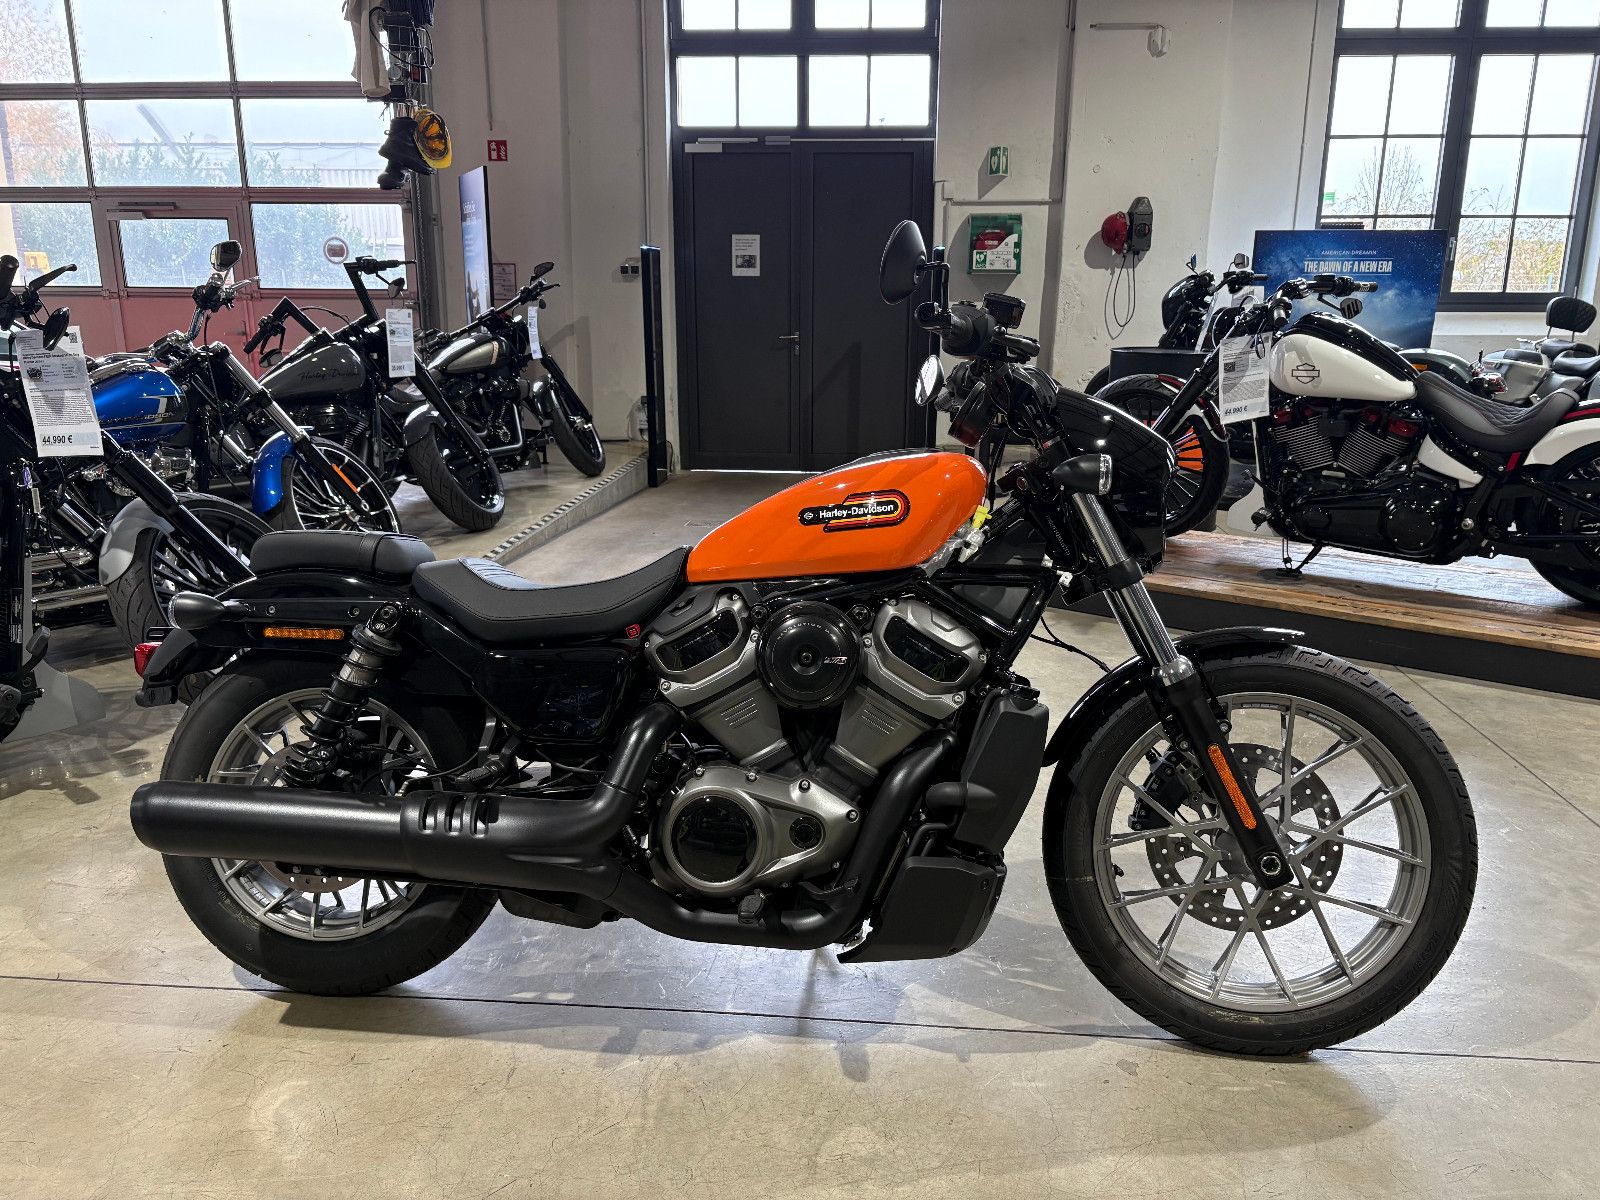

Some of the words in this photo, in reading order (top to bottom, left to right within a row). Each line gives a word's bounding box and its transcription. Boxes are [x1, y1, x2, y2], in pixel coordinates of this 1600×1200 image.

[1304, 261, 1319, 273] THE
[1319, 261, 1342, 273] DAWN
[1343, 261, 1353, 273] OF
[1353, 261, 1359, 273] A
[1359, 261, 1378, 273] NEW
[1377, 260, 1393, 273] ERA
[42, 436, 66, 445] 44.990
[67, 435, 73, 444] €
[819, 503, 894, 519] Harley-Davidson
